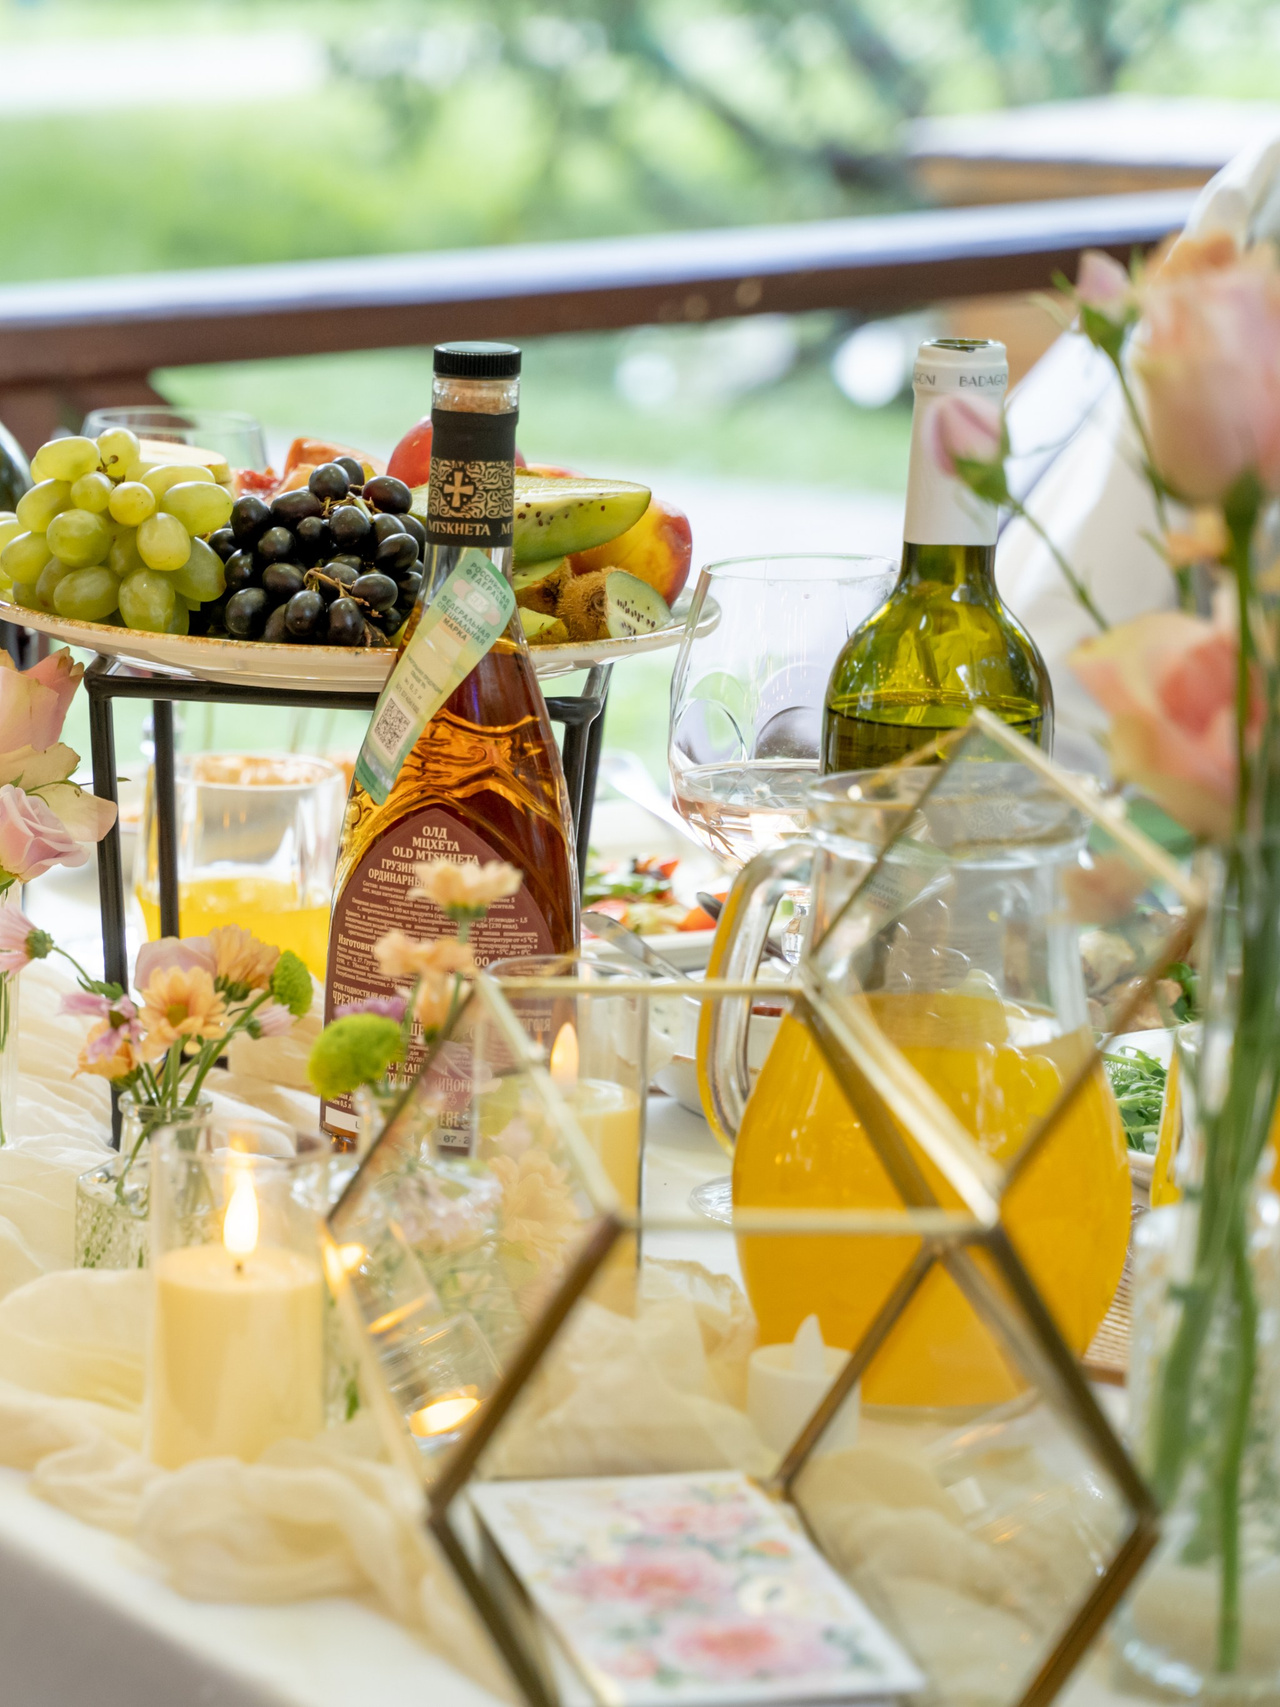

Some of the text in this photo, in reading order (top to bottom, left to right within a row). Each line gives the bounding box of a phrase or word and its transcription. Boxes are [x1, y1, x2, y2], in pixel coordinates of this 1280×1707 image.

[428, 520, 491, 536] MTSKHETA
[466, 568, 508, 611] ФЕДЕРАЦИЯ
[470, 562, 511, 606] РОССИЙСКАЯ
[436, 601, 486, 646] СПЕЦИАЛЬНАЯ
[441, 595, 491, 640] ФЕДЕРАЛЬНАЯ
[443, 617, 468, 641] МАРКА
[422, 825, 448, 840] ОЛД
[412, 837, 460, 852] МЦХЕТА
[392, 846, 480, 865] OLD MTSKHETA
[381, 858, 415, 874] ГРУЗИН
[368, 868, 428, 888] ОРДИНАРНЫ
[338, 933, 375, 952] Изготовит
